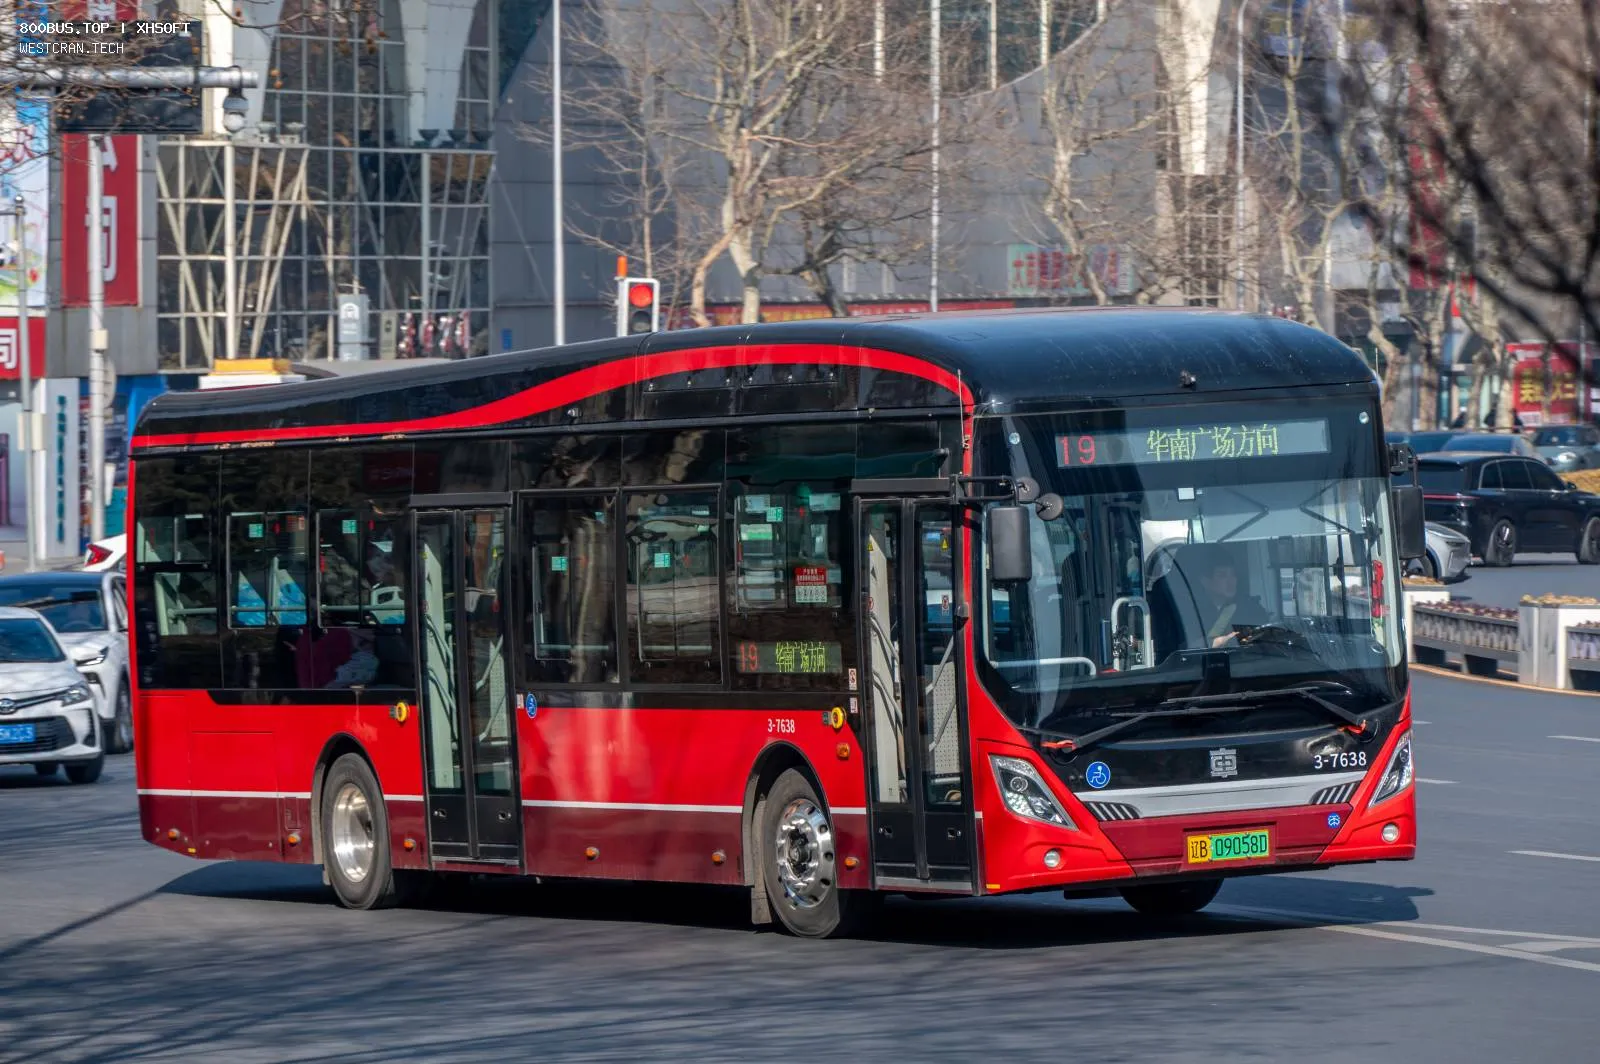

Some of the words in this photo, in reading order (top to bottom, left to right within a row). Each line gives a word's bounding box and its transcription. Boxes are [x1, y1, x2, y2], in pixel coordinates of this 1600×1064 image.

[1060, 434, 1096, 464] 19
[1146, 422, 1279, 462] 华南广场方向
[739, 641, 759, 672] 19
[767, 718, 796, 734] 3-7638
[1313, 751, 1367, 770] 3-7638
